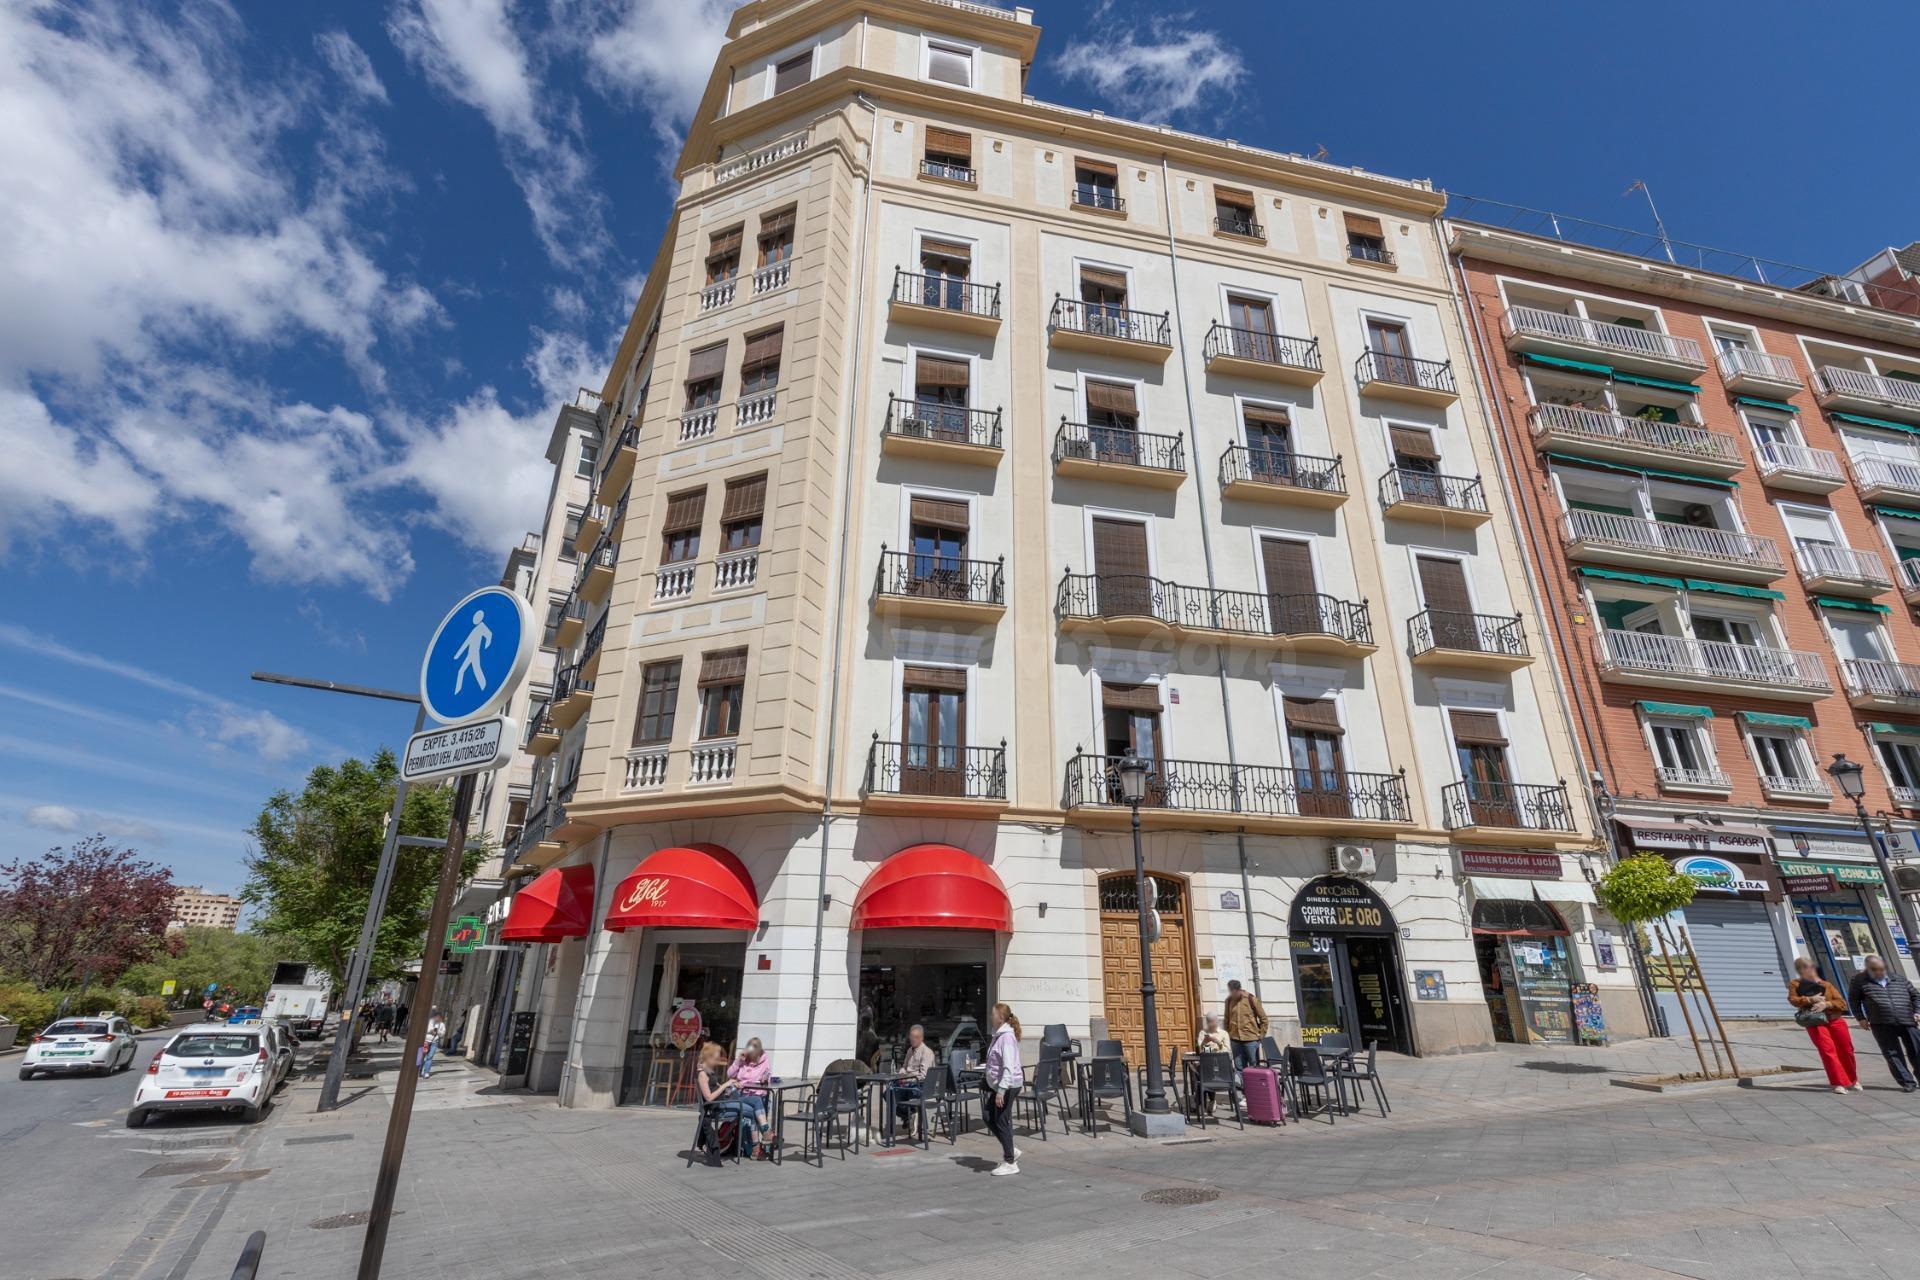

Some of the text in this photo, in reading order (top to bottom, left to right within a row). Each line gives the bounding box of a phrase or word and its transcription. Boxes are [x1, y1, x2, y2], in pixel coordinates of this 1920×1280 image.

[423, 735, 448, 751] EXPTE.
[408, 741, 496, 771] PERMITIDO VEH. AUTORIZADOS
[1637, 831, 1760, 847] RESTAURANTE ASADOR
[1464, 854, 1558, 867] ALIMENTACIÓN LUCÍA
[1838, 867, 1884, 881] BONOLOT
[1787, 877, 1829, 885] RESTAURANTE
[651, 900, 667, 908] 1917
[1301, 906, 1382, 926] COMPRA DE ORO
[1304, 915, 1337, 925] VENTA
[1301, 1026, 1341, 1037] EMPEÑO
